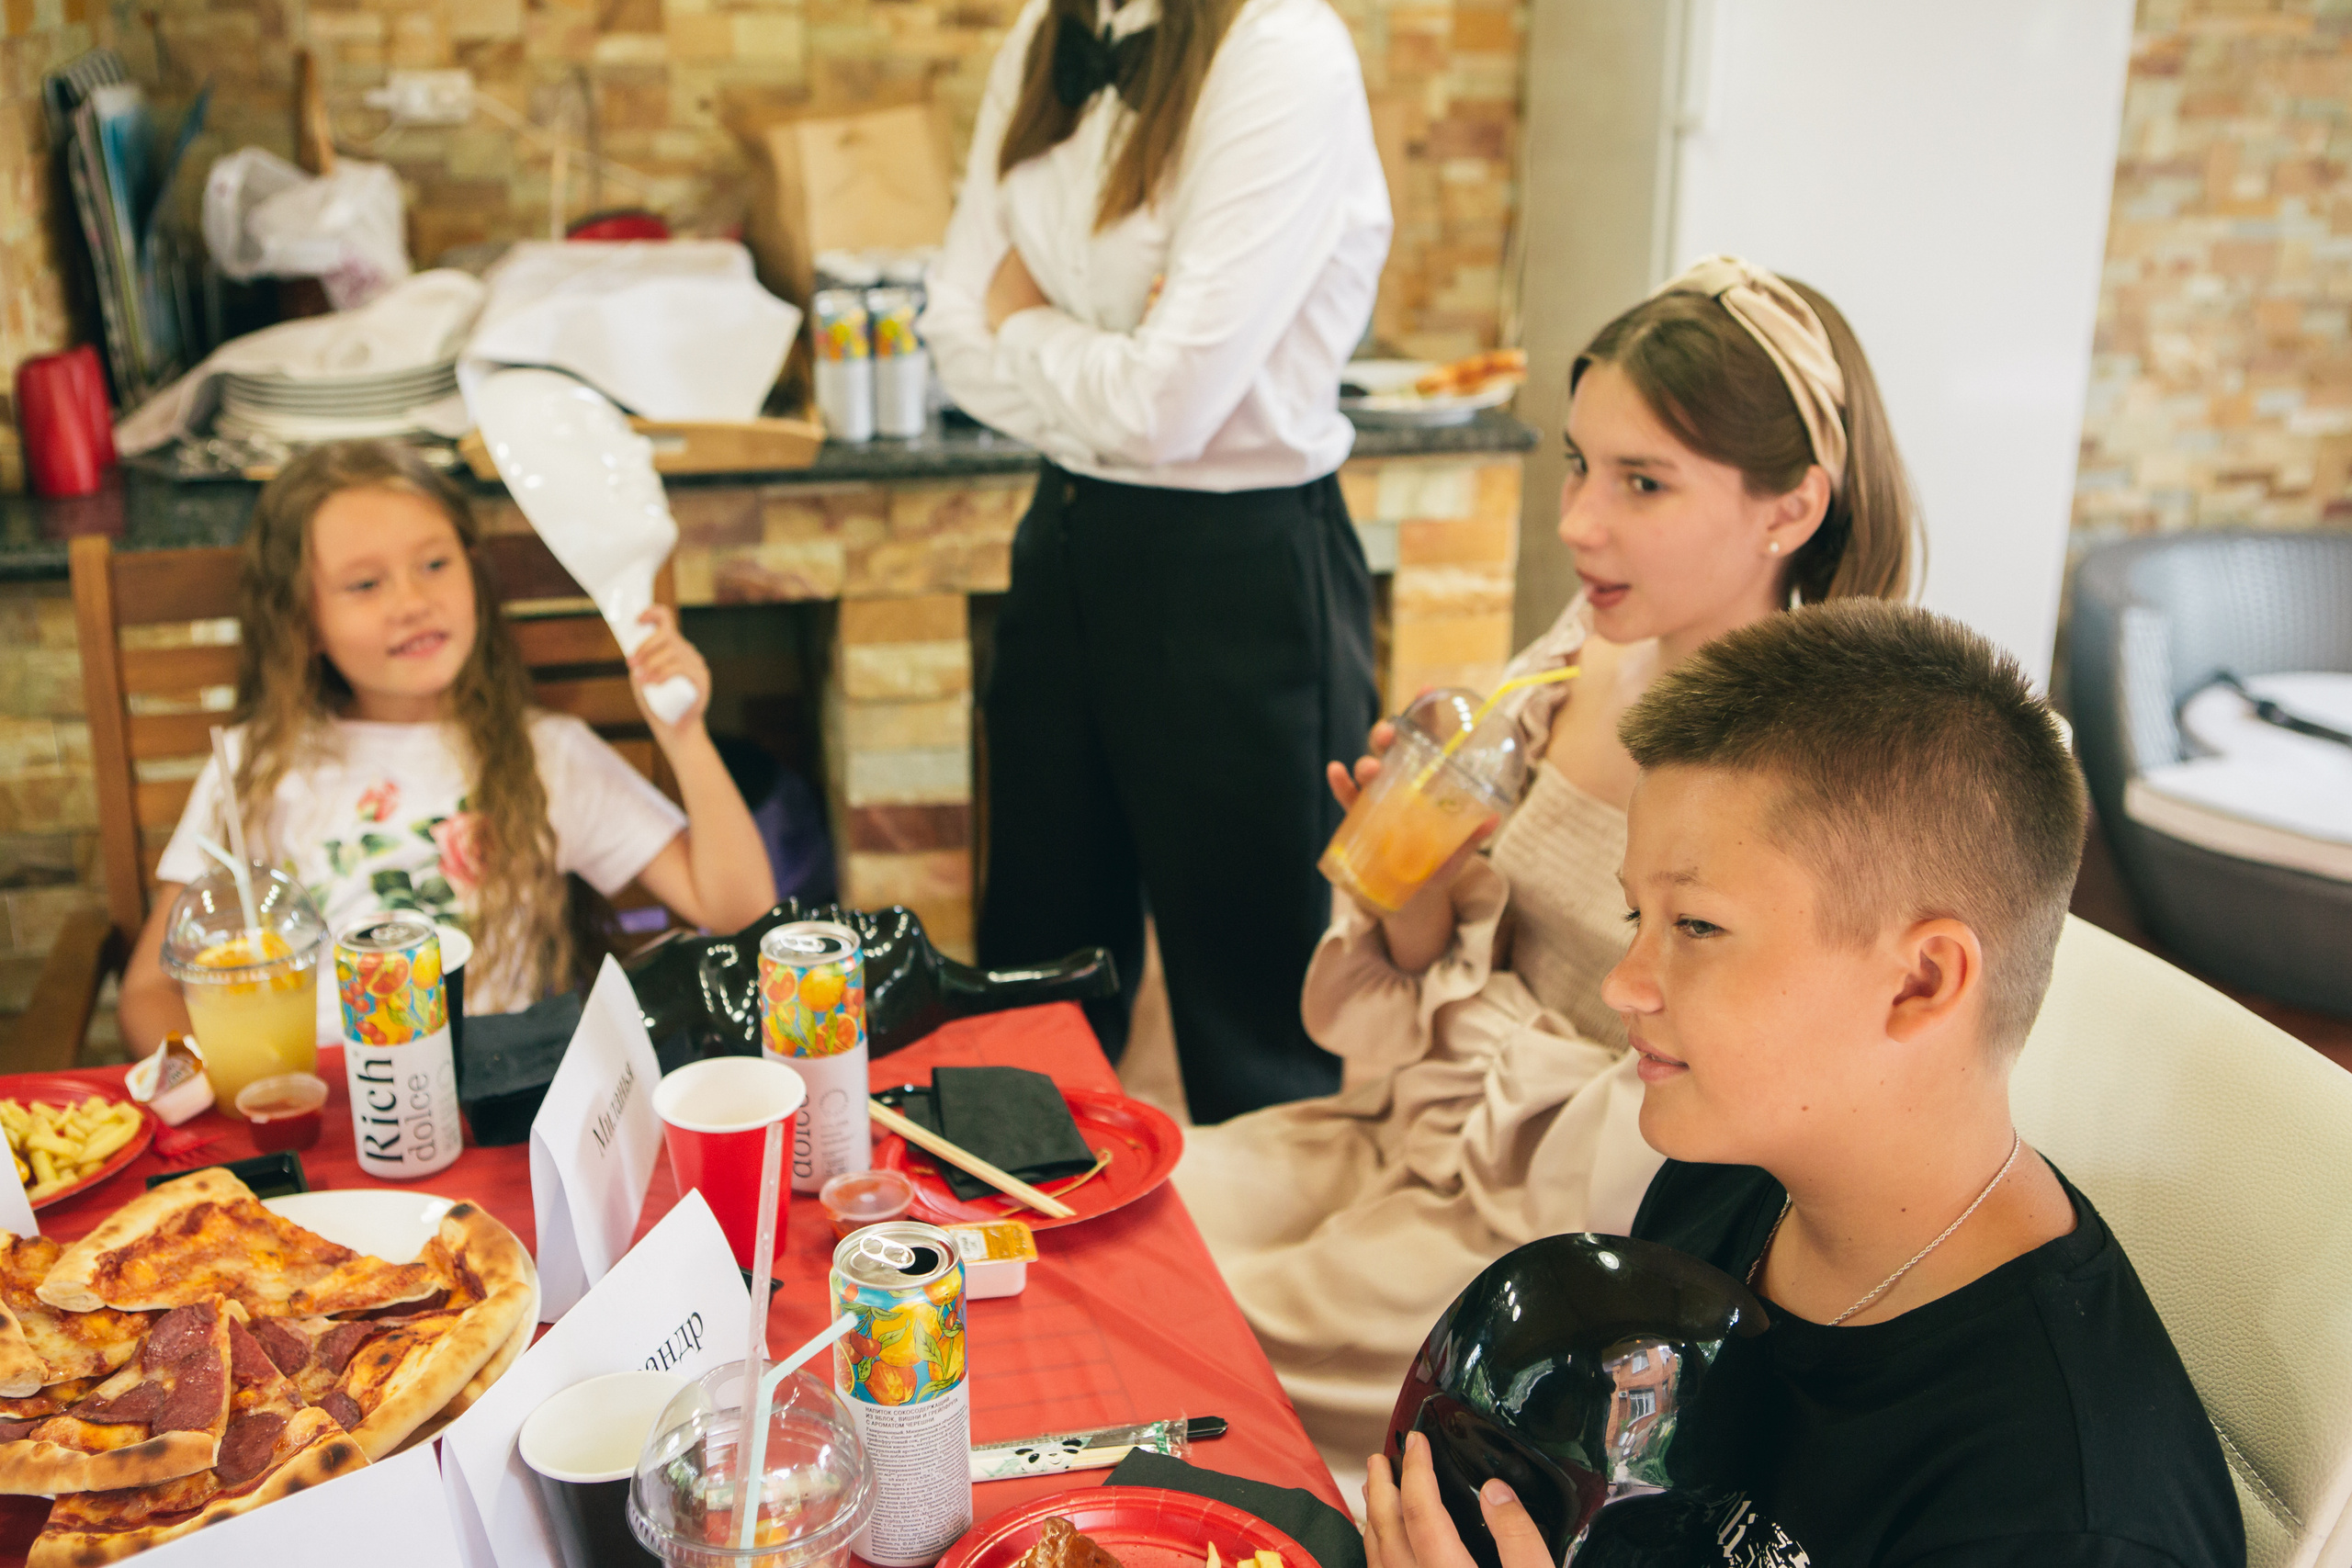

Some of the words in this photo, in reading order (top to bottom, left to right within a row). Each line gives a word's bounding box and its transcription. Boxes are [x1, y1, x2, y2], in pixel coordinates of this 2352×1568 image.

[356, 1056, 403, 1163] Rich
[404, 1072, 437, 1163] dolce
[637, 1312, 704, 1371] андр
[865, 1406, 891, 1416] НАПИТОК
